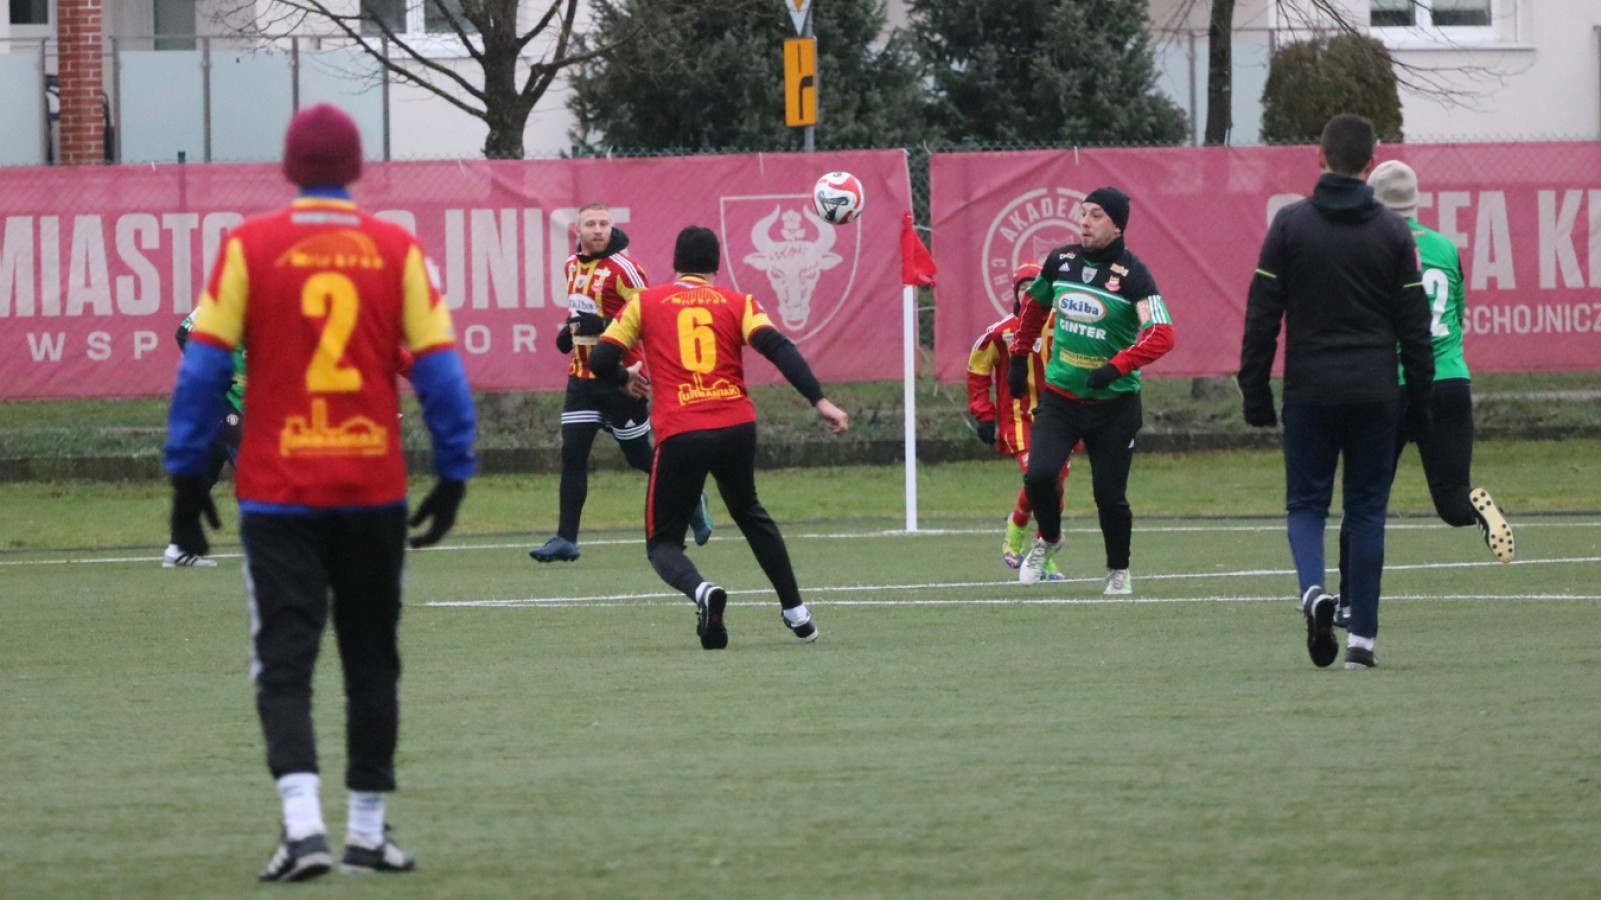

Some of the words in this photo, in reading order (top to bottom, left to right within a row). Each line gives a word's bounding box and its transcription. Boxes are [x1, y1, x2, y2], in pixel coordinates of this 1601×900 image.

[302, 272, 362, 393] 2
[1060, 298, 1099, 316] Skiba
[1422, 268, 1450, 338] 2
[677, 306, 717, 375] 6
